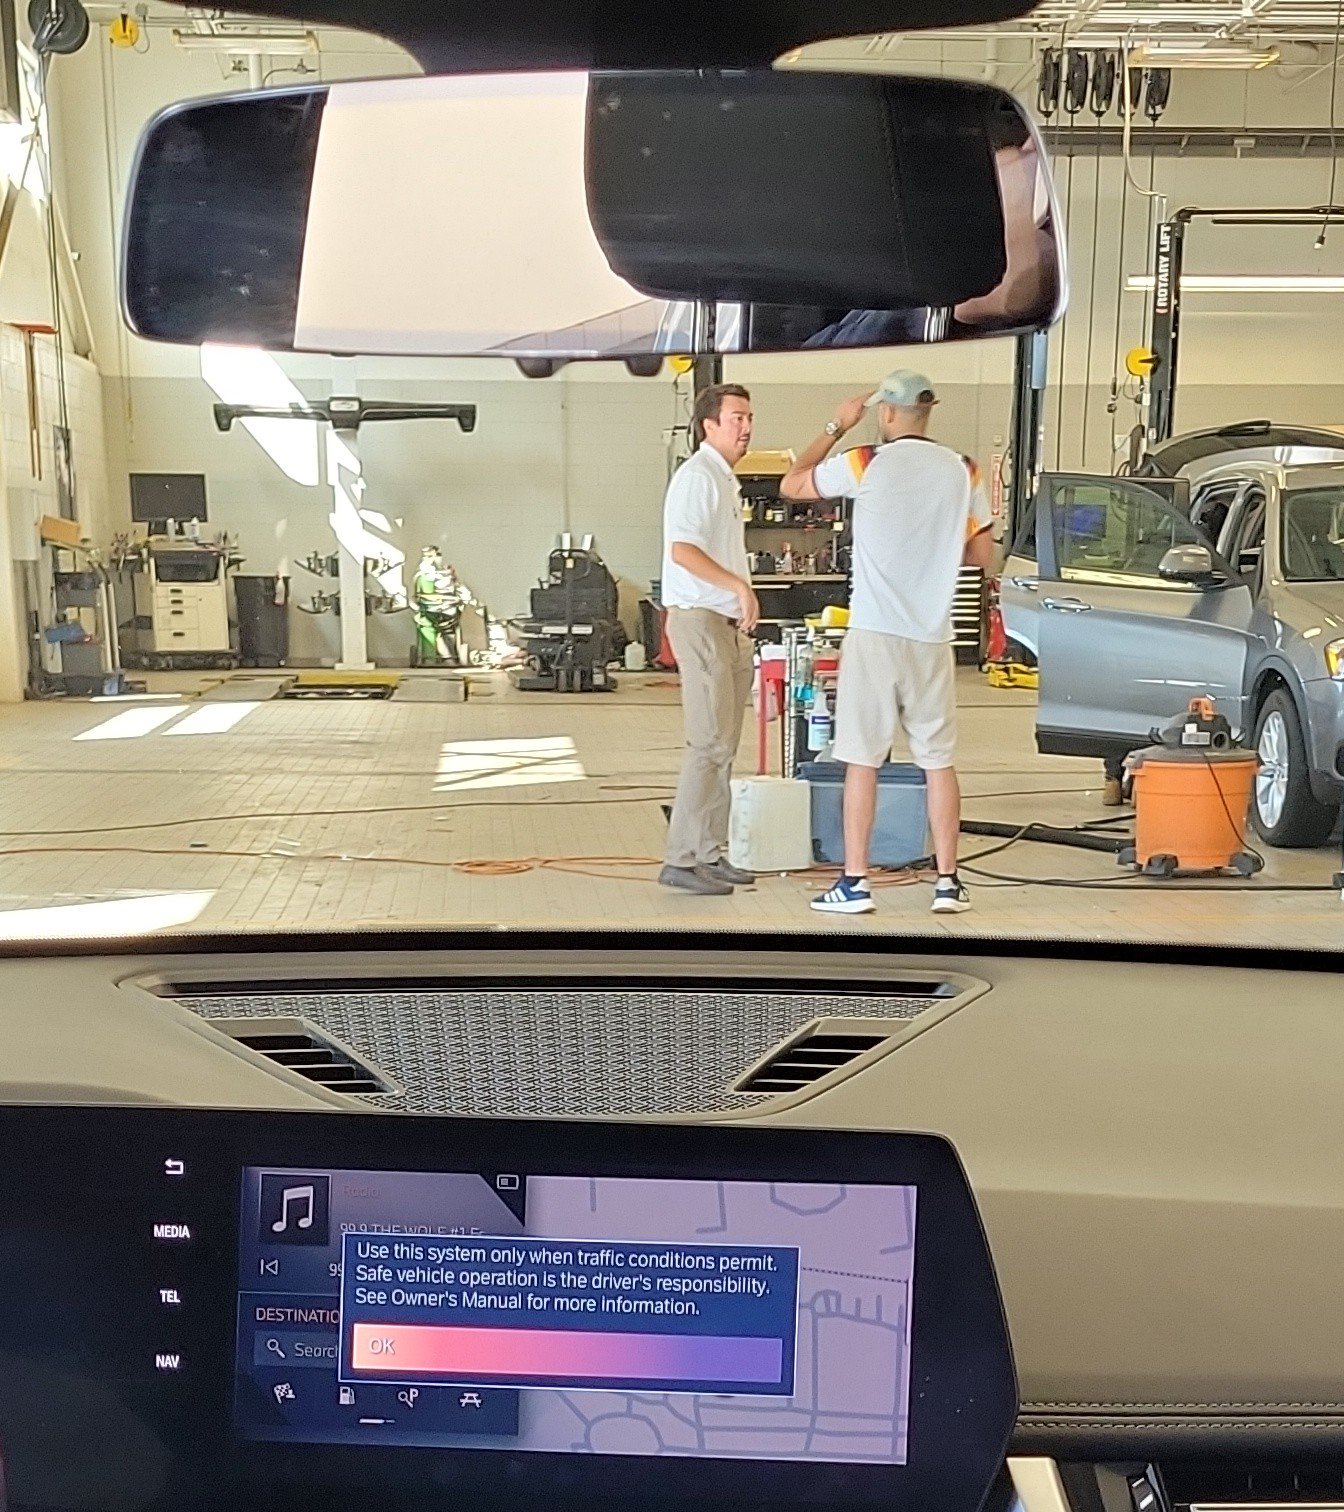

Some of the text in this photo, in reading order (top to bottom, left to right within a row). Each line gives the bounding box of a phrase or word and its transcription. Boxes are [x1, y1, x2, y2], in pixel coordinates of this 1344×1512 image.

[1156, 224, 1172, 307] ROTARY LIFT
[153, 1224, 191, 1239] MEDIA
[340, 1222, 368, 1232] 999
[357, 1241, 778, 1273] Use this system only when traffic conditions permit.
[356, 1264, 771, 1298] Safe vehicle operation is the driver's responsibility.
[159, 1289, 181, 1303] TEL
[355, 1287, 701, 1316] See Owner's Manual for more information.
[368, 1338, 396, 1355] OK
[155, 1354, 180, 1369] NAV
